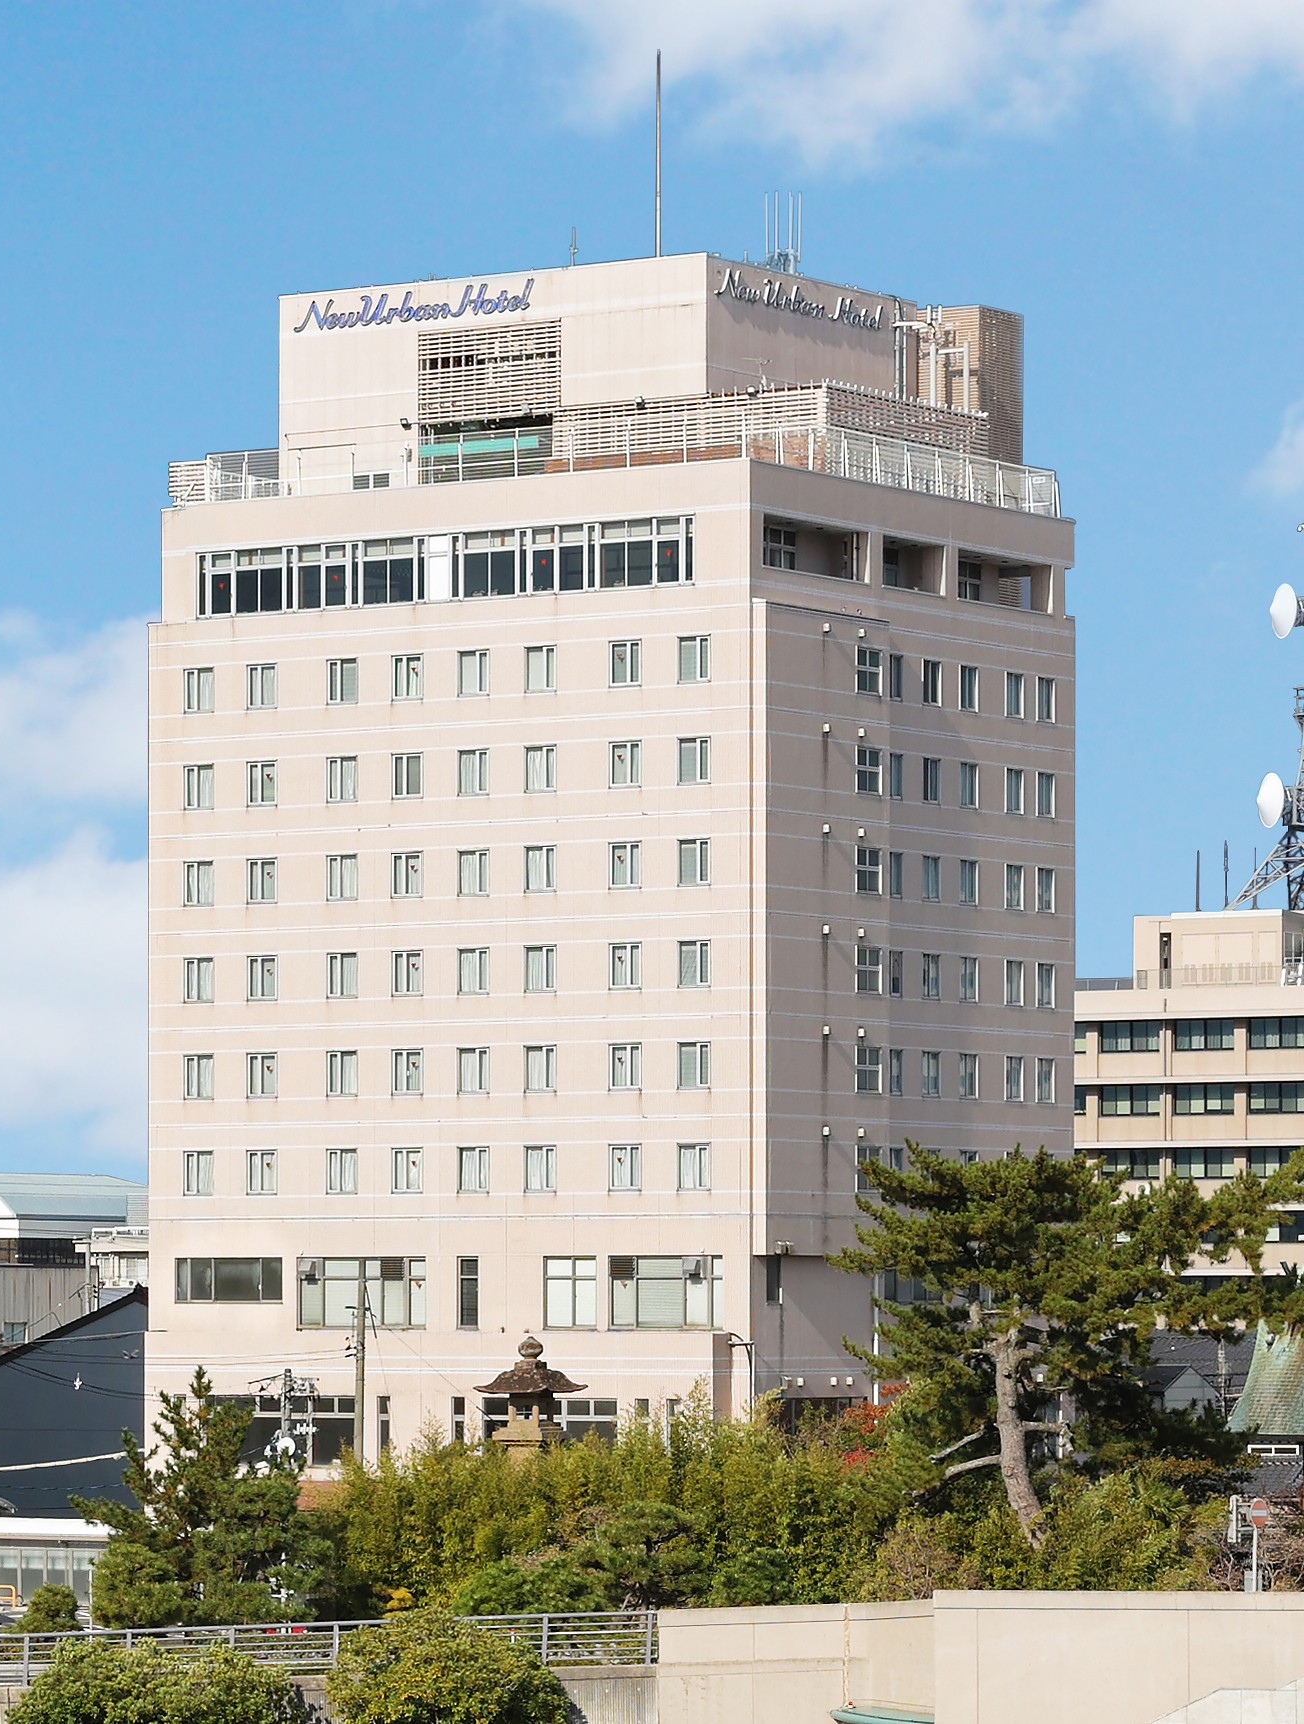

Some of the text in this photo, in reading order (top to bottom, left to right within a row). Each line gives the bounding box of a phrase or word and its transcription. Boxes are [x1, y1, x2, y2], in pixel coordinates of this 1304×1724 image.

[293, 278, 535, 333] New Urban Hotel
[714, 268, 883, 331] New Urban Hotel
